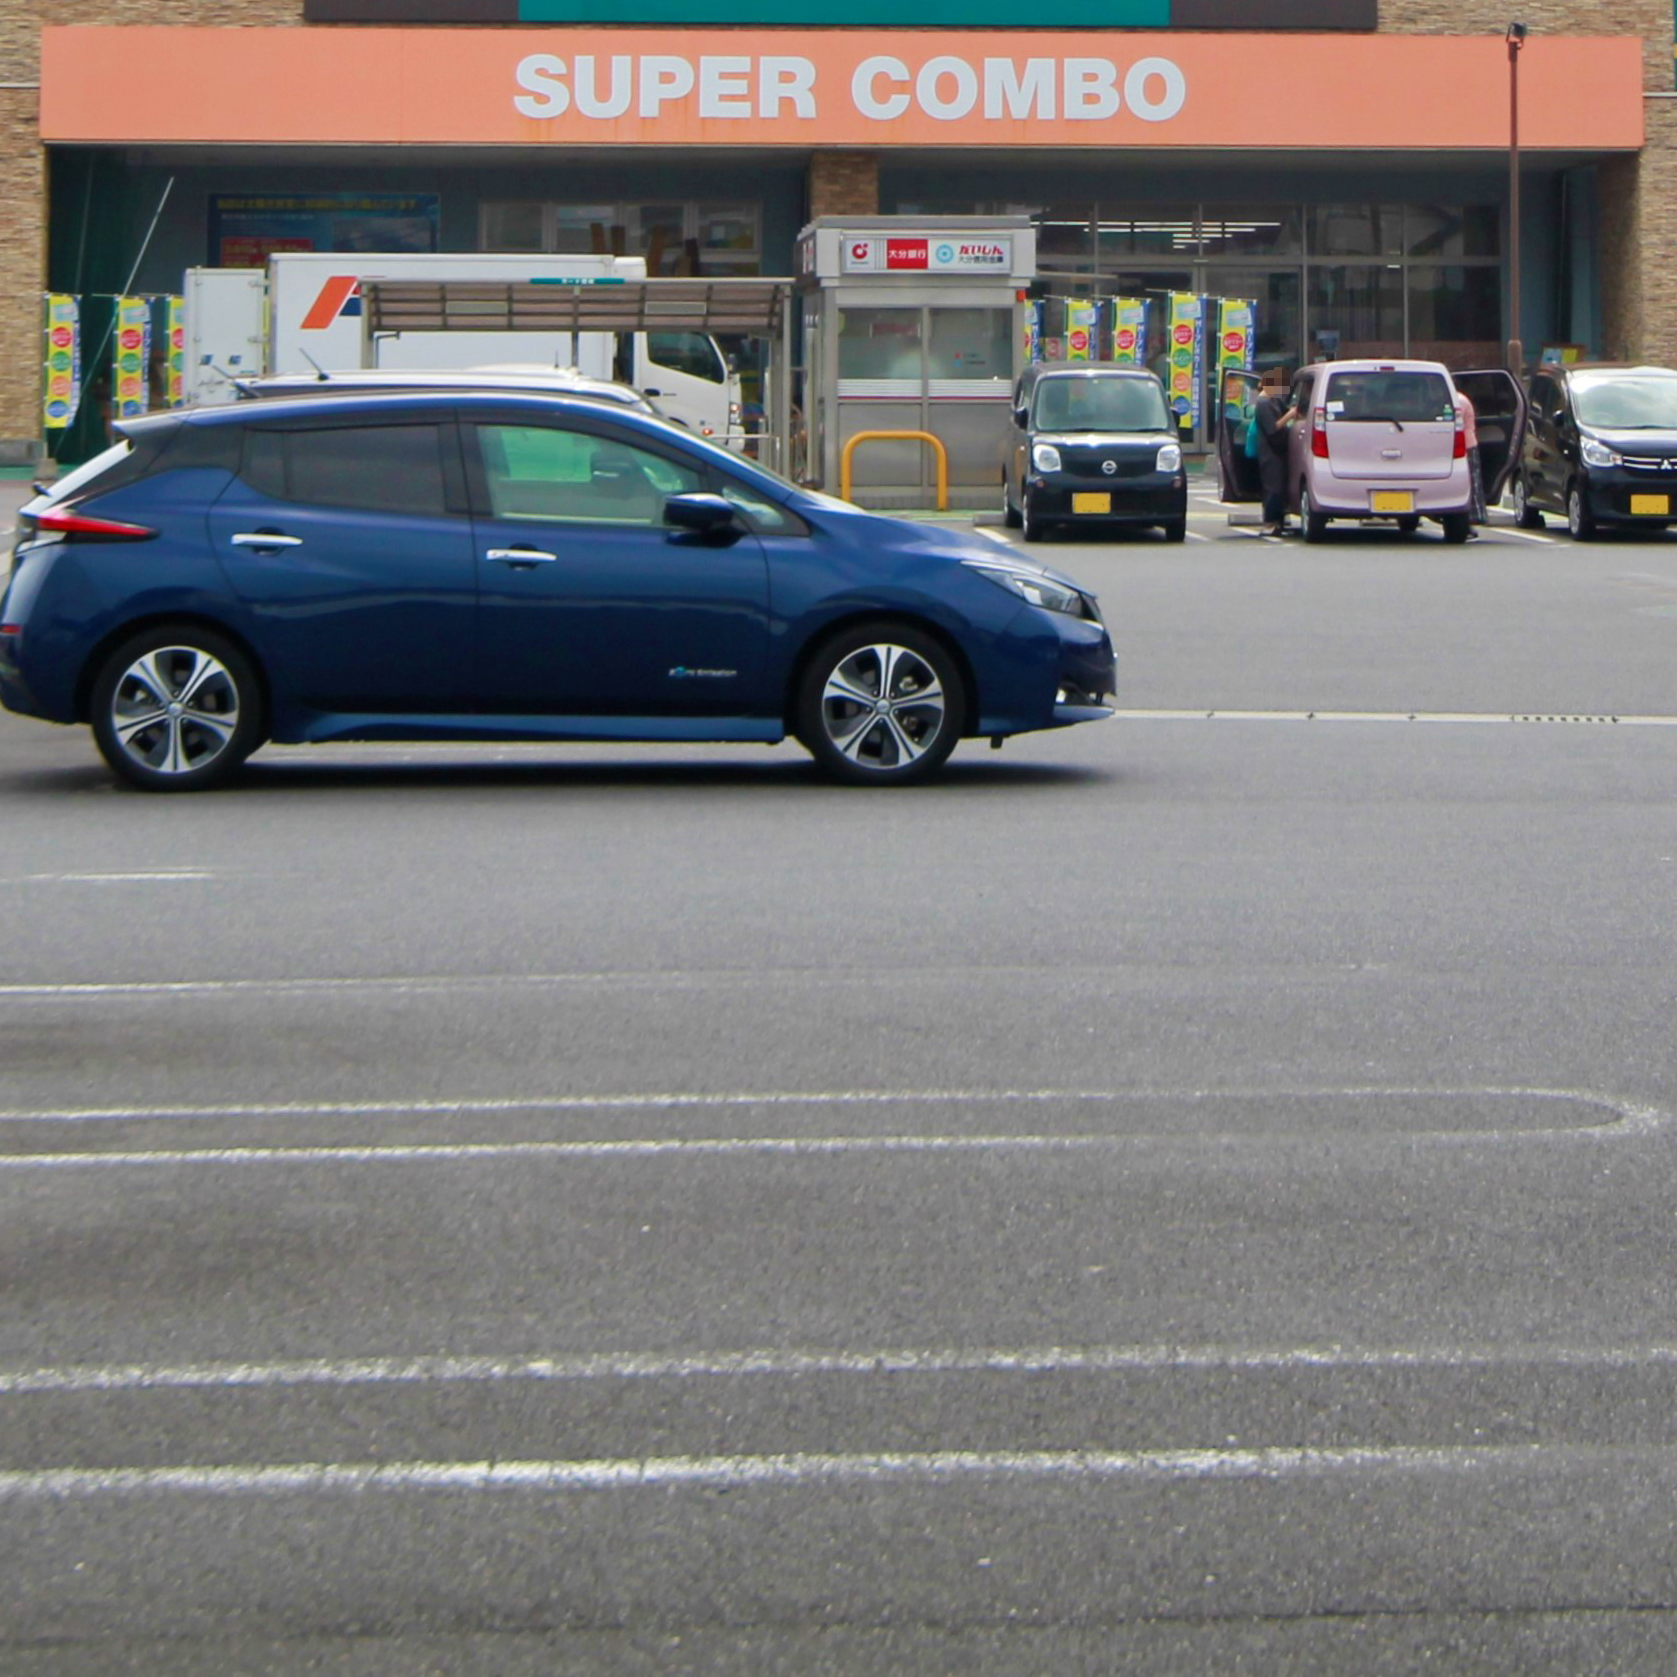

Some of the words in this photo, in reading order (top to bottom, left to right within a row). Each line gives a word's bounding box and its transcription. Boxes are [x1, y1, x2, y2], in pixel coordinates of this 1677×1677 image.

[513, 53, 817, 119] SUPER
[851, 55, 1186, 121] COMBO
[888, 249, 927, 260] 大分銀行
